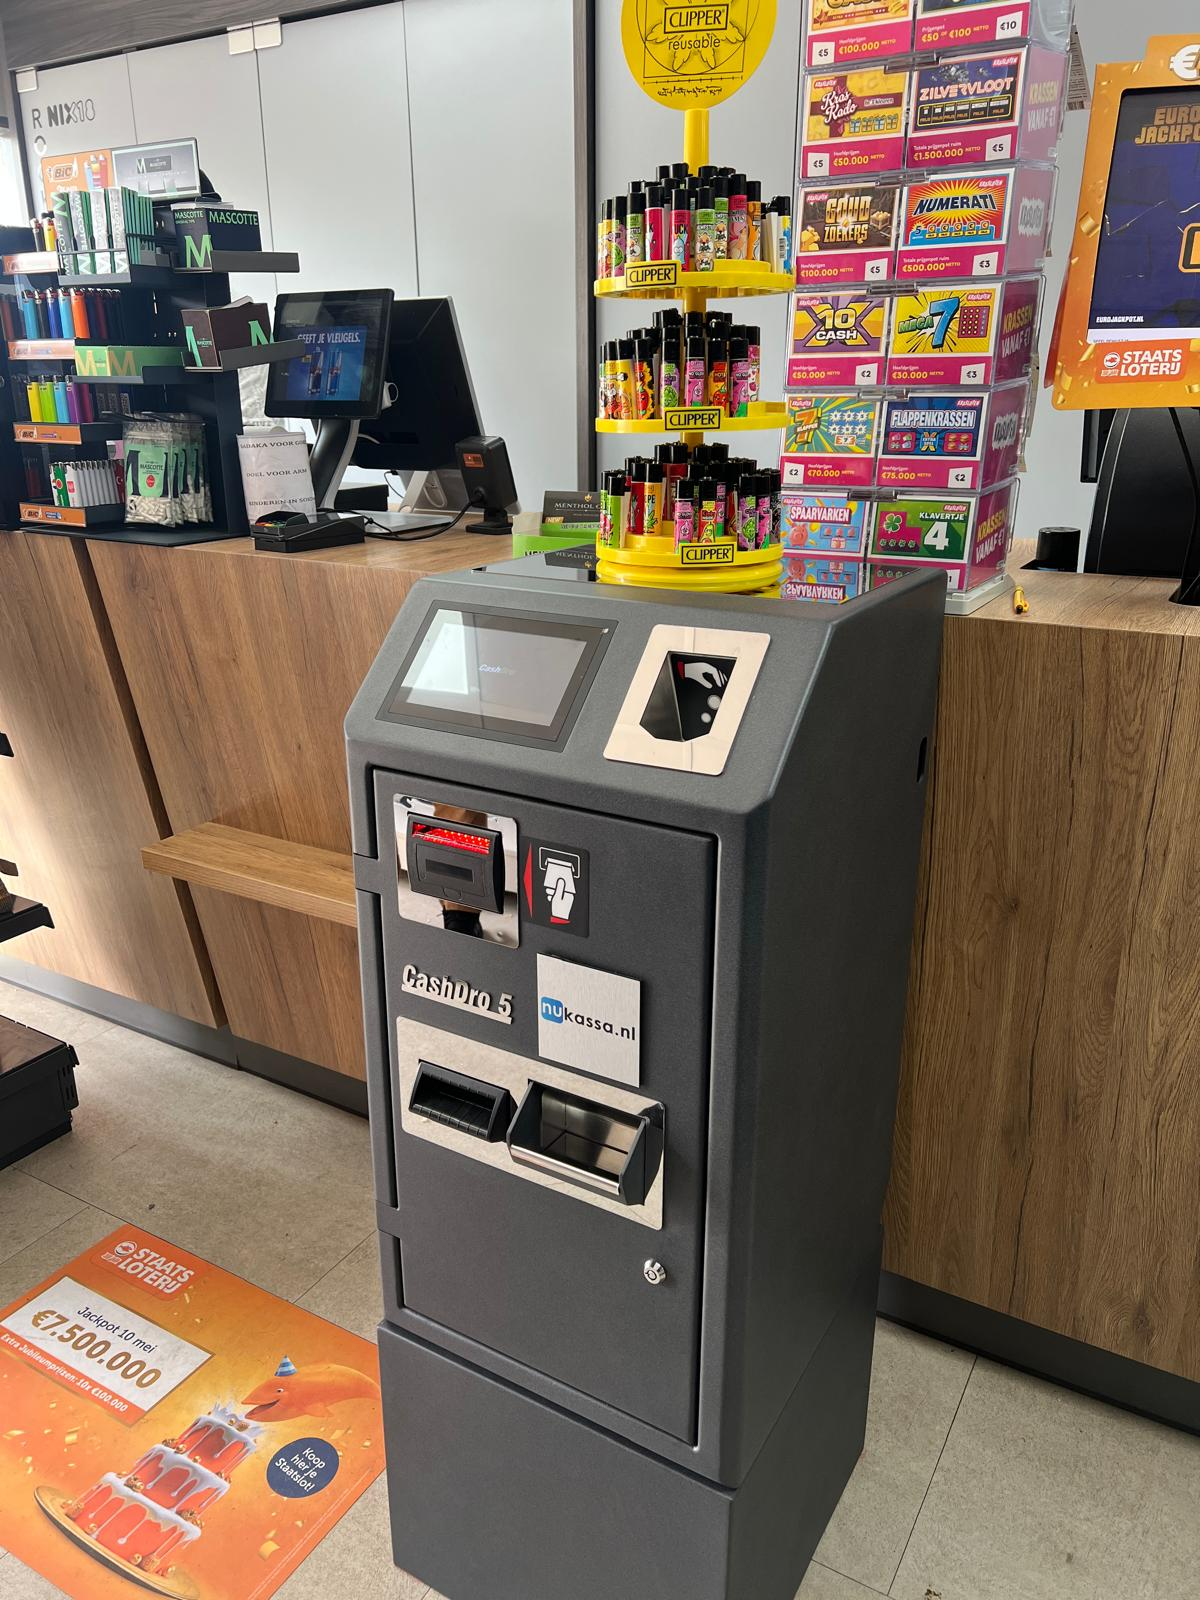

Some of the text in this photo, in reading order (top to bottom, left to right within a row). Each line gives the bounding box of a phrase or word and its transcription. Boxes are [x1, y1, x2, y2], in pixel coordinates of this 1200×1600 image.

[669, 9, 722, 28] CLIPPER
[1000, 21, 1017, 31] €10
[921, 32, 939, 42] €50
[949, 28, 971, 38] €100
[668, 37, 721, 51] reusable
[839, 41, 880, 55] €100.000
[818, 48, 829, 57] €5
[919, 77, 1014, 101] ZILVERVLOOT
[821, 90, 851, 111] Kras
[824, 98, 857, 124] Kado
[1135, 123, 1200, 144] JACKPO
[914, 148, 964, 161] €1.500.000
[992, 144, 1004, 152] €5
[813, 160, 824, 168] €5
[834, 156, 869, 167] €50.000
[826, 195, 872, 224] GOUD
[913, 194, 997, 216] NUMERATI
[174, 210, 205, 220] MASCOTTE
[208, 211, 259, 226] MASCOTTE
[824, 224, 869, 243] ZOEKERS
[184, 234, 213, 269] M
[870, 266, 880, 274] €5
[902, 263, 945, 272] €500.000
[980, 260, 990, 268] €3
[629, 267, 671, 283] CLIPPER
[800, 269, 838, 277] €100.000
[817, 308, 856, 330] 10
[898, 315, 934, 334] MEGA
[929, 296, 960, 349] 7
[1003, 304, 1034, 334] KRASSEN
[318, 334, 326, 344] JE
[816, 330, 858, 340] CASH
[1002, 330, 1023, 358] VANAF
[1122, 350, 1182, 364] STAATS
[862, 370, 870, 378] €2
[1120, 362, 1181, 376] LOTERIJ
[670, 414, 714, 426] CLIPPER
[892, 411, 975, 428] FLAPPENKRASSEN
[882, 472, 915, 480] €75.000
[954, 474, 966, 482] €2
[554, 502, 594, 510] MENTHOL
[791, 506, 850, 522] SPAARVARKEN
[920, 512, 964, 520] KLAVERTJE
[977, 505, 1008, 543] KRASSEN
[924, 521, 949, 550] 4
[686, 548, 730, 560] CLIPPER
[976, 537, 998, 564] VANAF
[402, 964, 513, 1017] CashDro 5
[542, 1001, 636, 1041] nukassa.nl
[133, 1248, 194, 1282] STAATS
[118, 1258, 182, 1294] LOTERIJ
[78, 1306, 158, 1354] Jackpot 10 mei
[31, 1309, 162, 1389] €7.500.000
[0, 1333, 18, 1350] Extra
[76, 1379, 92, 1392] 10x
[91, 1388, 128, 1412] €100.000
[290, 1454, 317, 1478] hier je
[302, 1448, 326, 1468] Koop
[275, 1458, 316, 1492] Staatslot!
